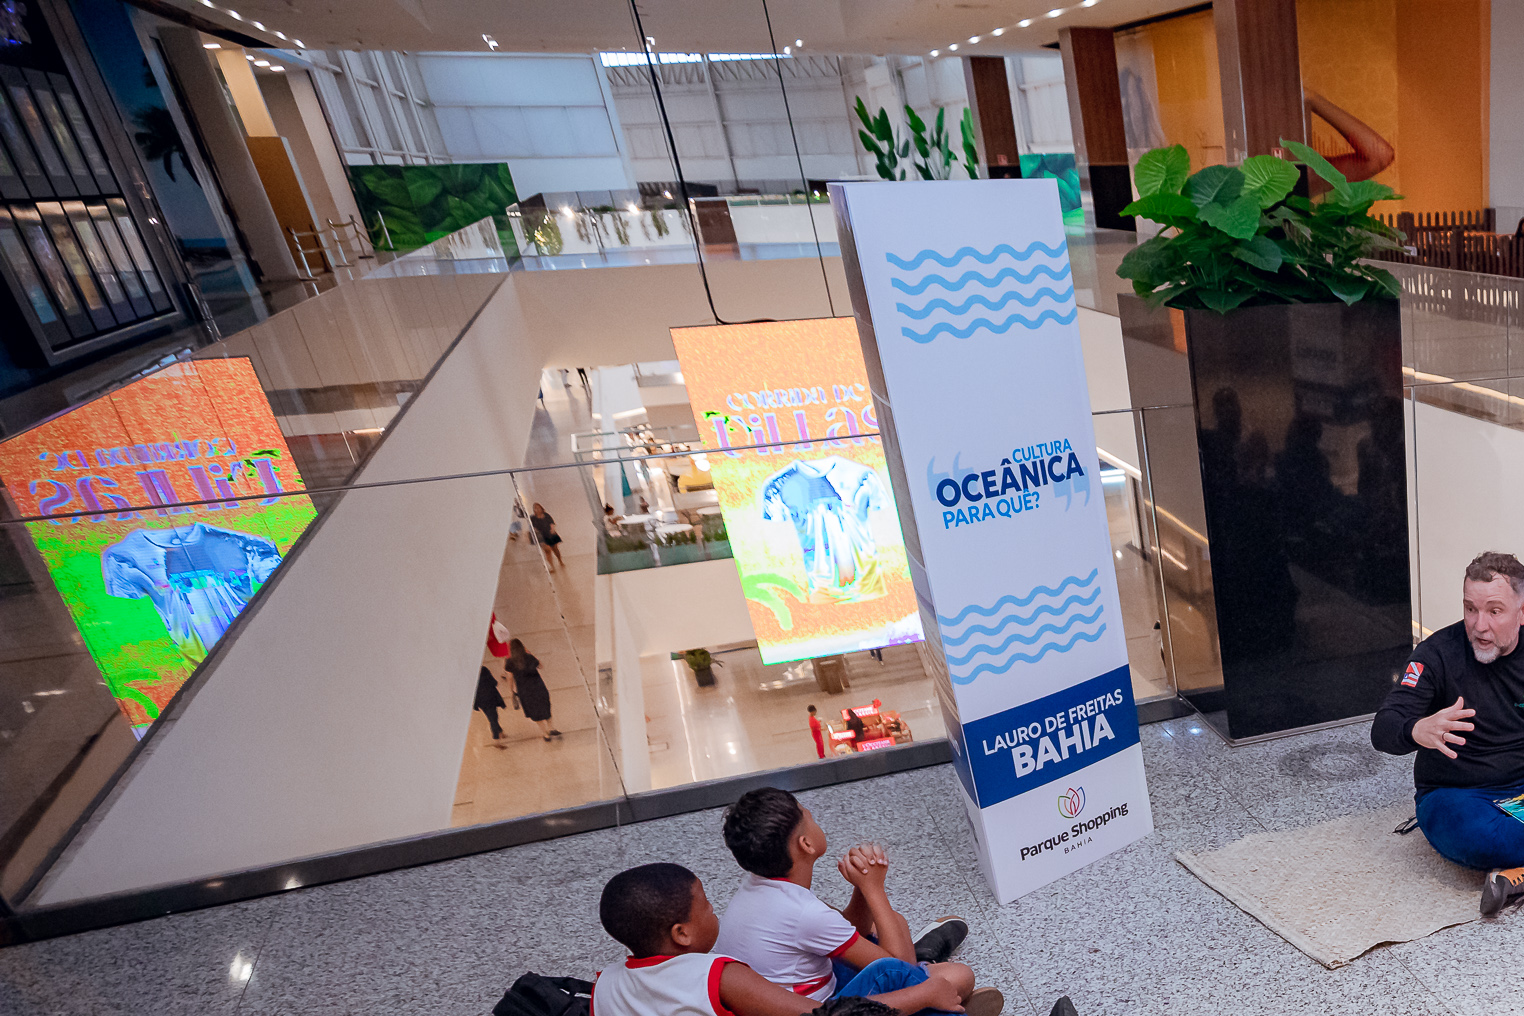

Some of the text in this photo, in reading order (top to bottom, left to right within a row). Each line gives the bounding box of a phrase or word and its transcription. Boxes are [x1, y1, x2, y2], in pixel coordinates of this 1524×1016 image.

[1012, 438, 1073, 463] CULTURA
[936, 451, 1085, 507] OCEÂNICA
[942, 488, 1040, 529] PARA QUÊ?
[982, 722, 1042, 755] LAURO
[1045, 712, 1067, 733] DE
[1069, 688, 1123, 724] FREITAS
[1011, 713, 1116, 778] BAHIA
[1019, 802, 1129, 861] Parque Shopping
[1064, 836, 1094, 855] BAHIA
